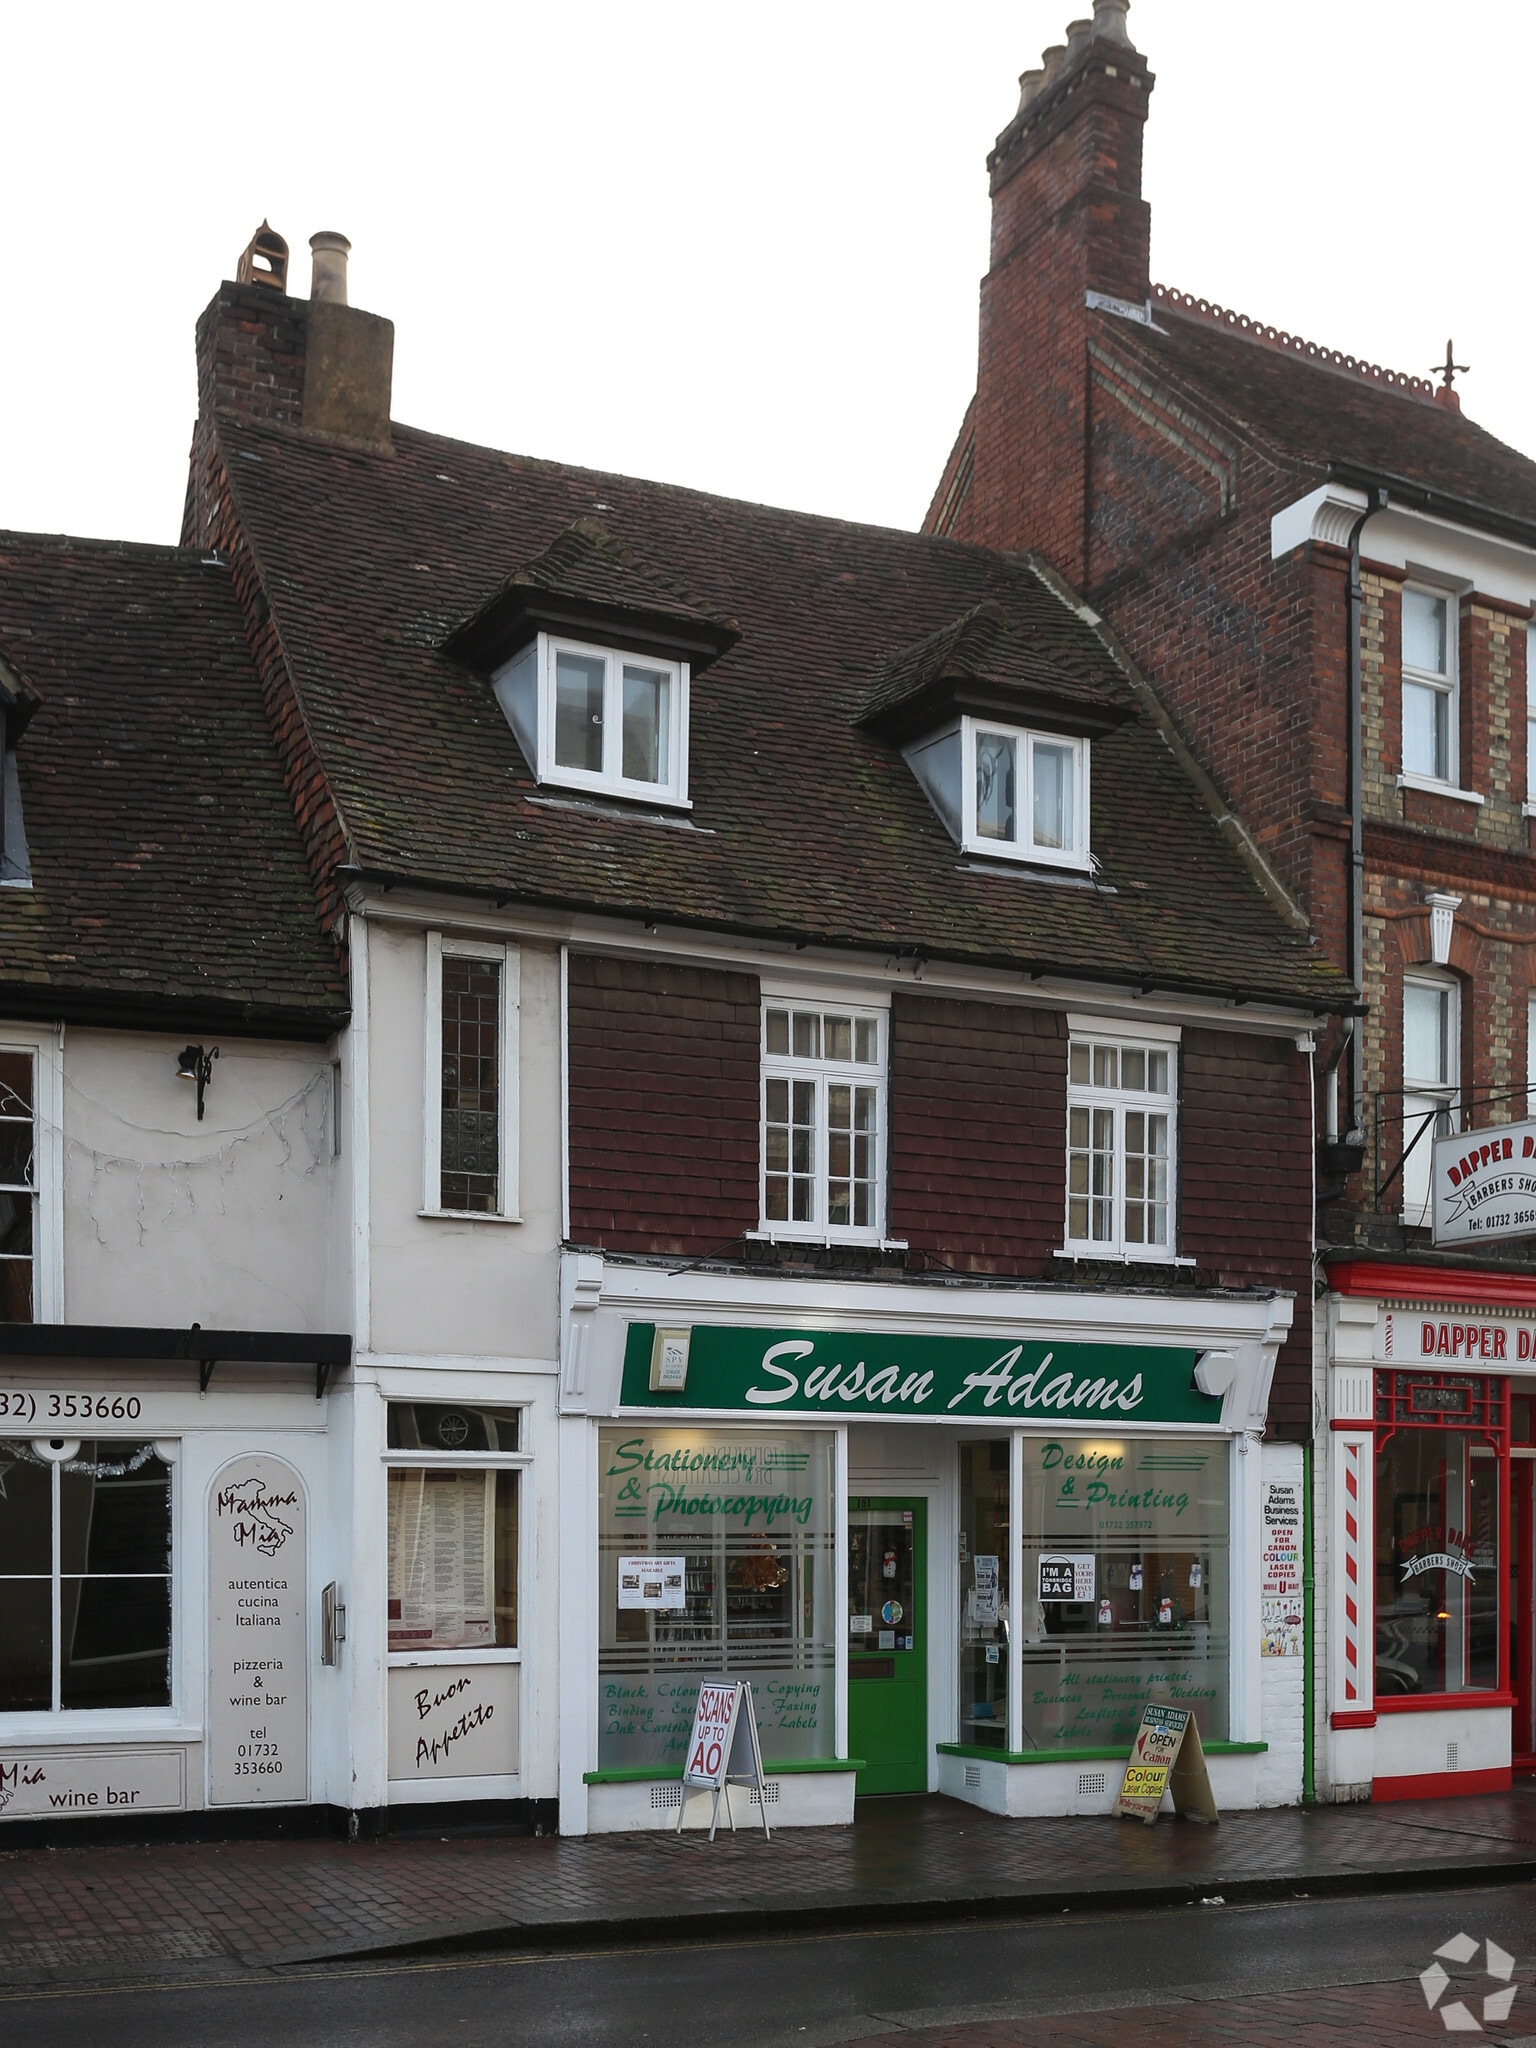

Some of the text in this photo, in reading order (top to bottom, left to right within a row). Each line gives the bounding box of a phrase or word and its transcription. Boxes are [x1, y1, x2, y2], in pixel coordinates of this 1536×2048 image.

[1447, 1138, 1513, 1188] DAPPER
[1469, 1178, 1513, 1206] BARBERS
[1468, 1209, 1536, 1231] Tel: 01732 3656
[1421, 1321, 1507, 1360] DAPPER
[745, 1339, 1145, 1411] Susan Adams
[48, 1394, 141, 1419] 353660
[606, 1439, 756, 1482] Stationery
[1041, 1443, 1124, 1479] Design
[1061, 1476, 1189, 1517] & Printing
[1269, 1485, 1293, 1494] Susan
[218, 1491, 297, 1517] Mamma
[617, 1477, 812, 1527] & Photocopying
[857, 1498, 871, 1509] 161
[1268, 1495, 1295, 1504] Adams
[1264, 1505, 1299, 1515] Business
[1125, 1521, 1153, 1529] 357872
[1265, 1516, 1298, 1525] Services
[240, 1522, 280, 1547] Mia
[1398, 1526, 1442, 1553] DAPPER
[1263, 1553, 1299, 1561] COLOUR
[1413, 1556, 1464, 1573] BARBERS SHOP
[1042, 1567, 1072, 1577] I'M A
[228, 1578, 288, 1590] autentica
[1042, 1583, 1072, 1593] BAG
[1279, 1581, 1287, 1594] U
[237, 1596, 279, 1608] cucina
[235, 1614, 281, 1626] Italiana
[233, 1658, 283, 1674] pizzeria
[253, 1676, 263, 1688] &
[1060, 1670, 1192, 1687] All stationery printed:
[603, 1684, 649, 1699] Black,
[767, 1680, 820, 1699] Copying
[1033, 1686, 1217, 1704] Business Personal Wedding
[229, 1693, 287, 1706] wine bar
[414, 1679, 471, 1720] Buon
[698, 1690, 734, 1724] SCANS
[772, 1698, 817, 1714] Faxing
[606, 1703, 653, 1719] Binding
[1147, 1707, 1164, 1718] SUSAN
[1165, 1709, 1187, 1721] ADAMS
[605, 1721, 634, 1735] Ink
[778, 1715, 818, 1728] Labels
[250, 1726, 267, 1738] tel
[416, 1703, 494, 1768] Appetito
[698, 1725, 725, 1741] UP TO
[1149, 1733, 1176, 1748] OPEN
[238, 1744, 279, 1757] 01732
[1143, 1751, 1172, 1765] Canon
[234, 1761, 283, 1775] 353660
[1127, 1769, 1165, 1782] Colour
[0, 1763, 46, 1792] Mia
[48, 1786, 140, 1807] wine bar
[1123, 1783, 1162, 1795] Laser Copies
